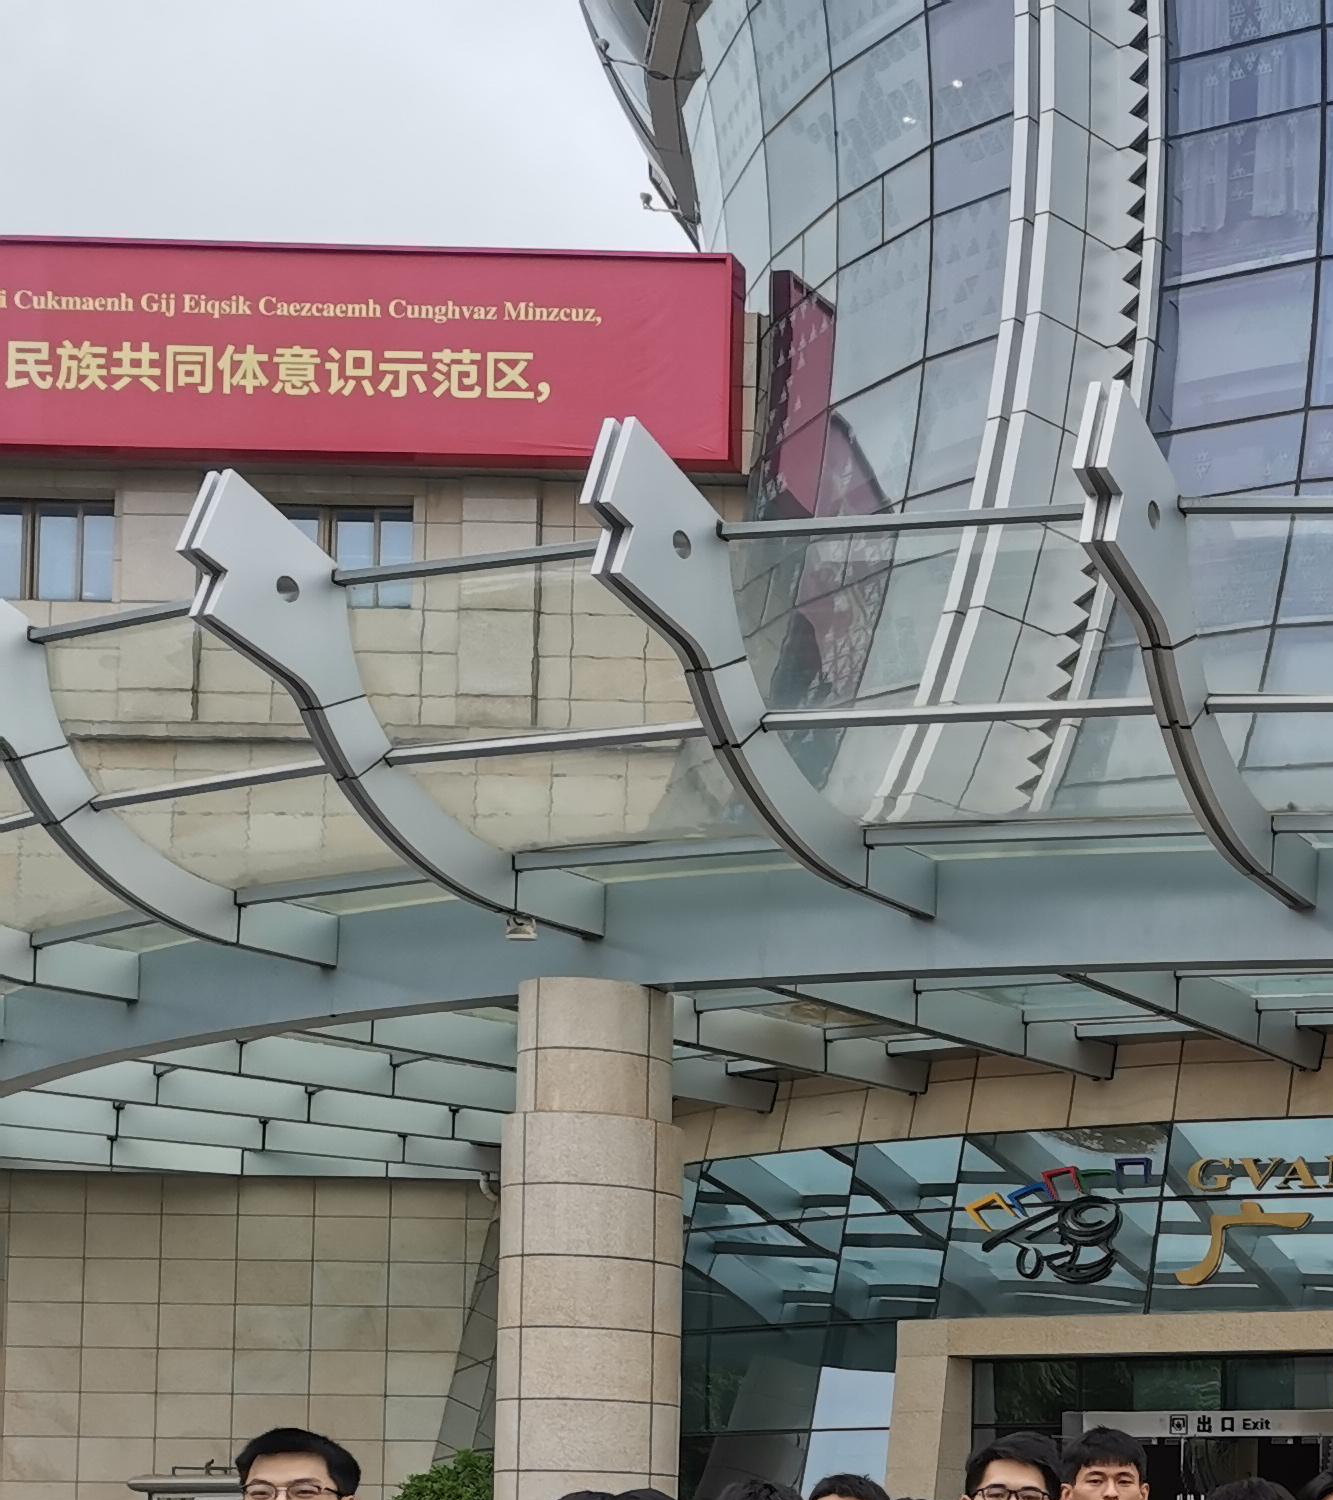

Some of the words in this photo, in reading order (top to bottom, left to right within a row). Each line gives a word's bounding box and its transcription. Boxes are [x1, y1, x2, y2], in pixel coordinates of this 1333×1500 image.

[14, 290, 134, 312] Cukmaenh
[140, 293, 176, 317] Gij
[182, 294, 252, 318] Eiqsik
[388, 299, 498, 324] Cunghvaz
[503, 301, 603, 327] Minzcuz,
[1197, 1414, 1235, 1433] 出口
[1242, 1418, 1271, 1430] Exit
